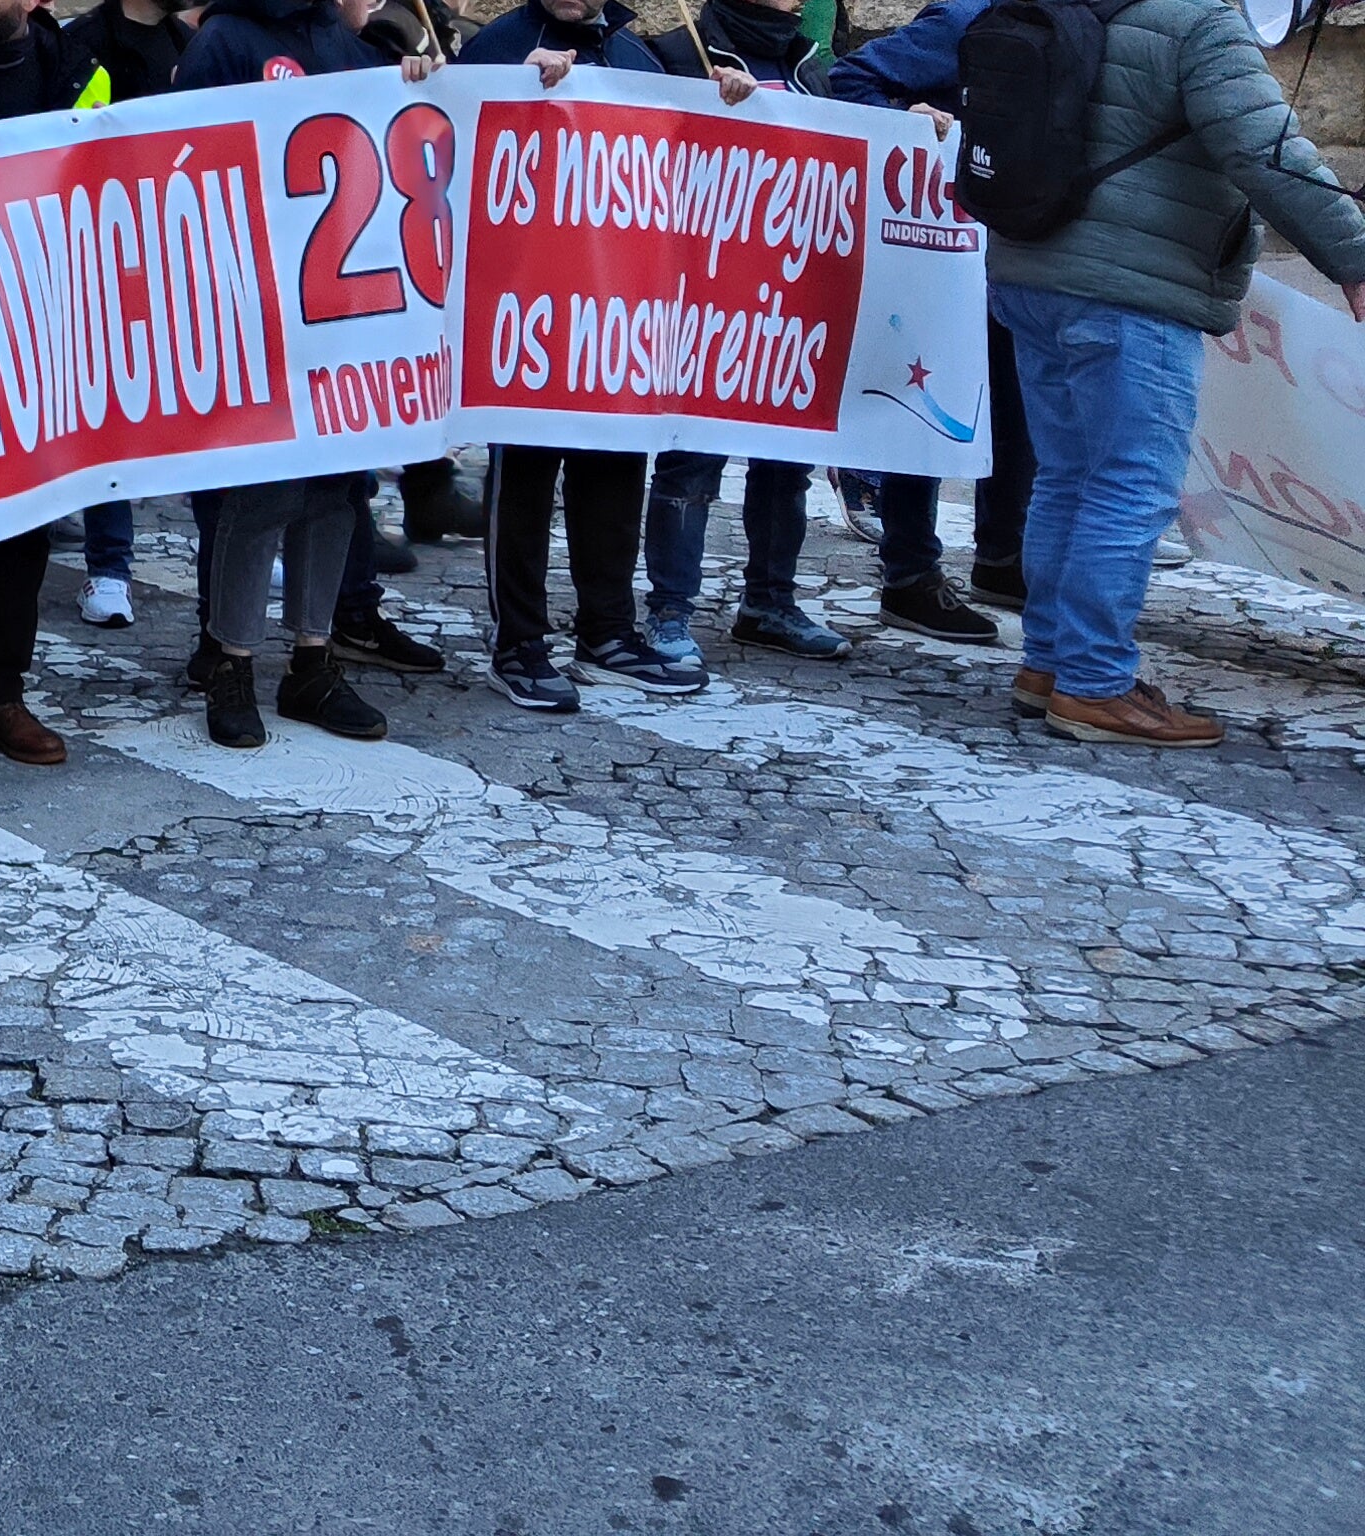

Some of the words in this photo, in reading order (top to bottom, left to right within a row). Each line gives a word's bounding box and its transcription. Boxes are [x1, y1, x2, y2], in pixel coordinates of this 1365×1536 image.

[284, 101, 456, 325] 28
[486, 128, 541, 226] os
[554, 127, 671, 232] nosos
[671, 140, 859, 283] empregos
[883, 221, 973, 247] INDUSTRIA
[491, 291, 553, 392] os
